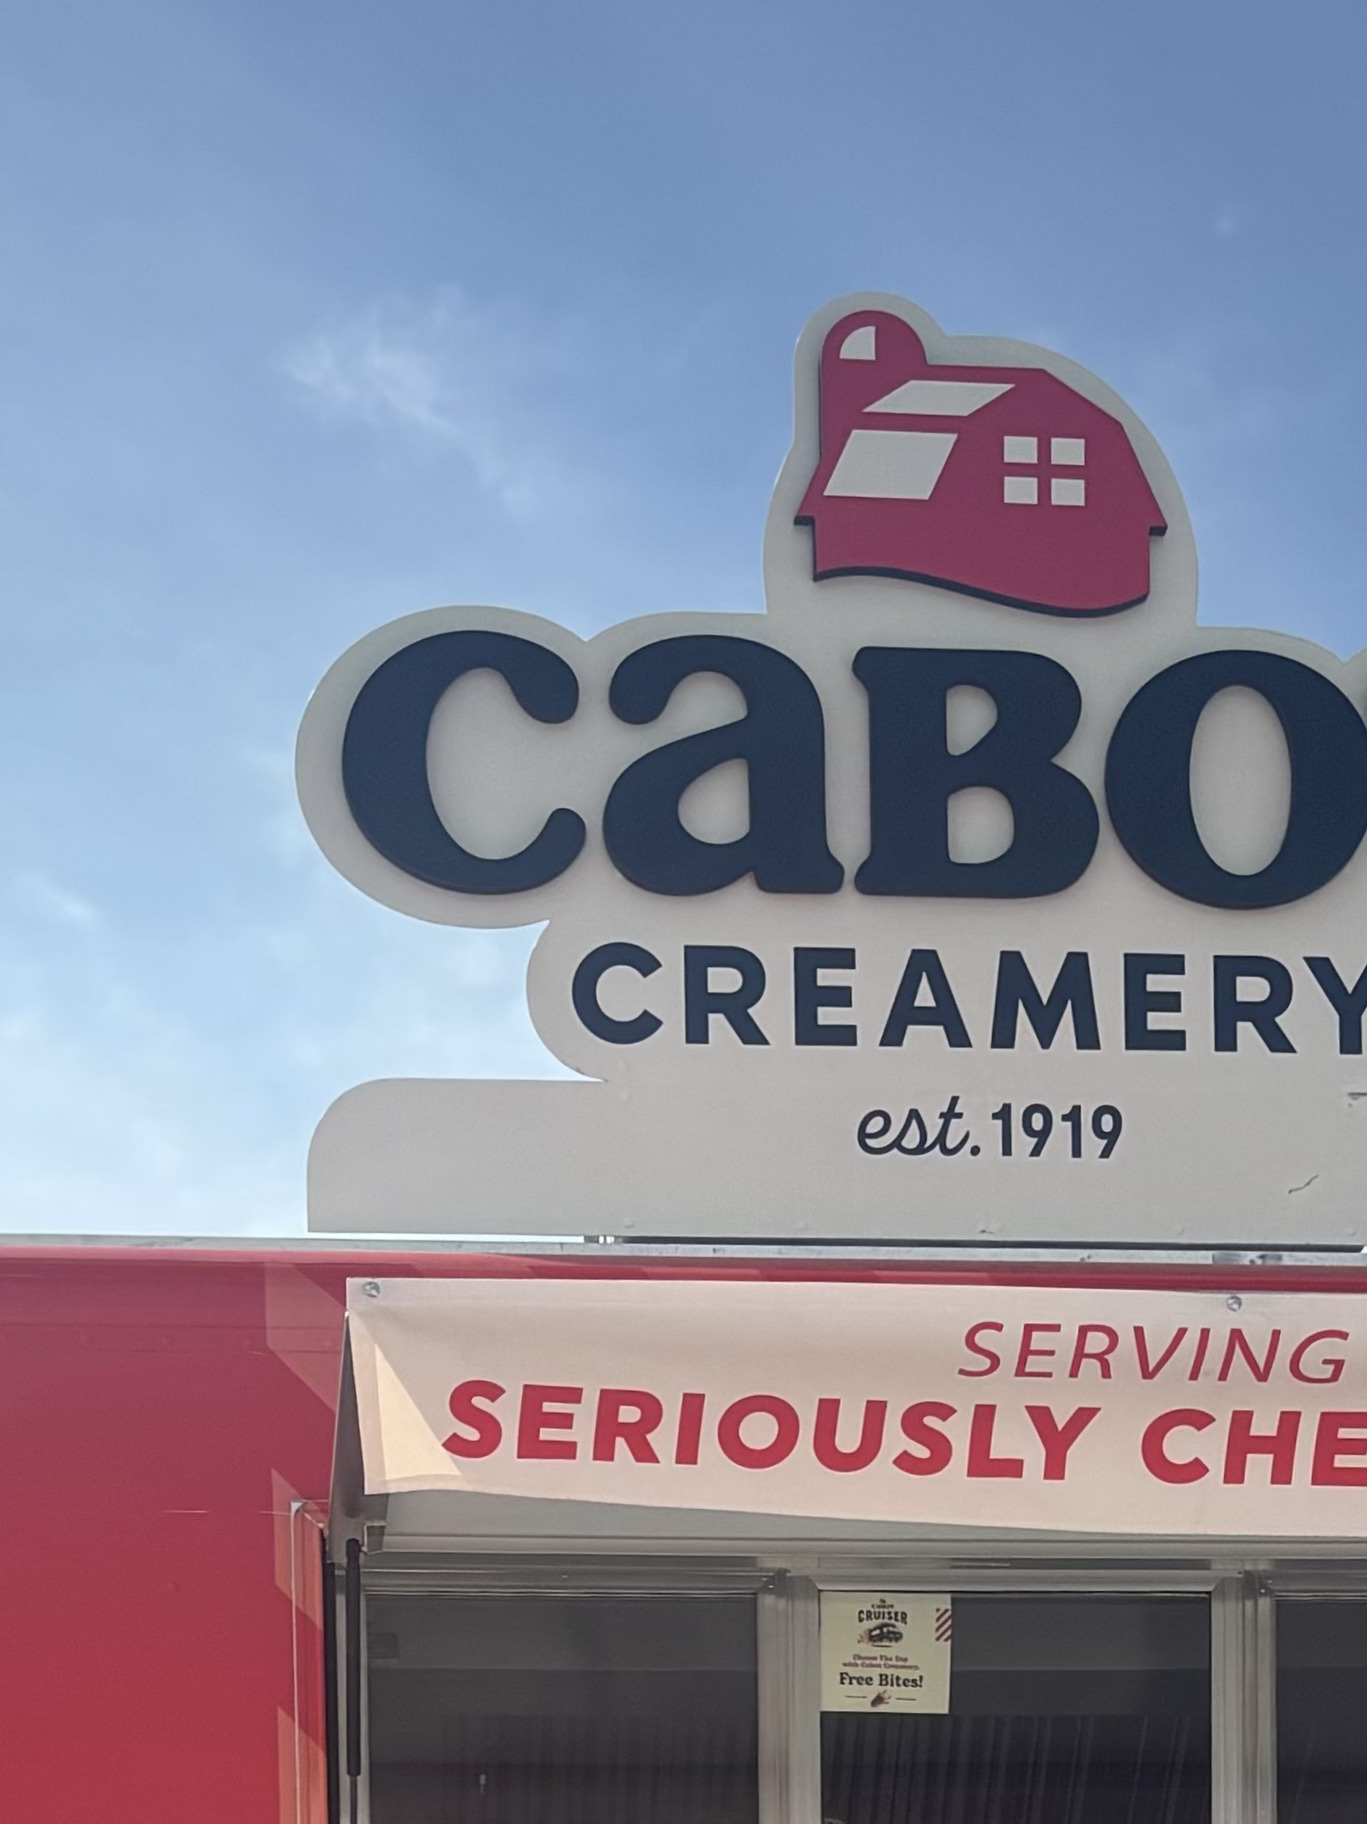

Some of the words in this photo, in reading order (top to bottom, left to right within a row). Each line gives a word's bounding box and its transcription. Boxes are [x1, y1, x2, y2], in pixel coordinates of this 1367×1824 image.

[957, 1321, 1350, 1386] SERVING
[441, 1377, 1098, 1483] SERIOUSLY
[858, 1609, 908, 1625] CRUISER
[839, 1672, 873, 1686] Free
[878, 1673, 924, 1688] Bites!
